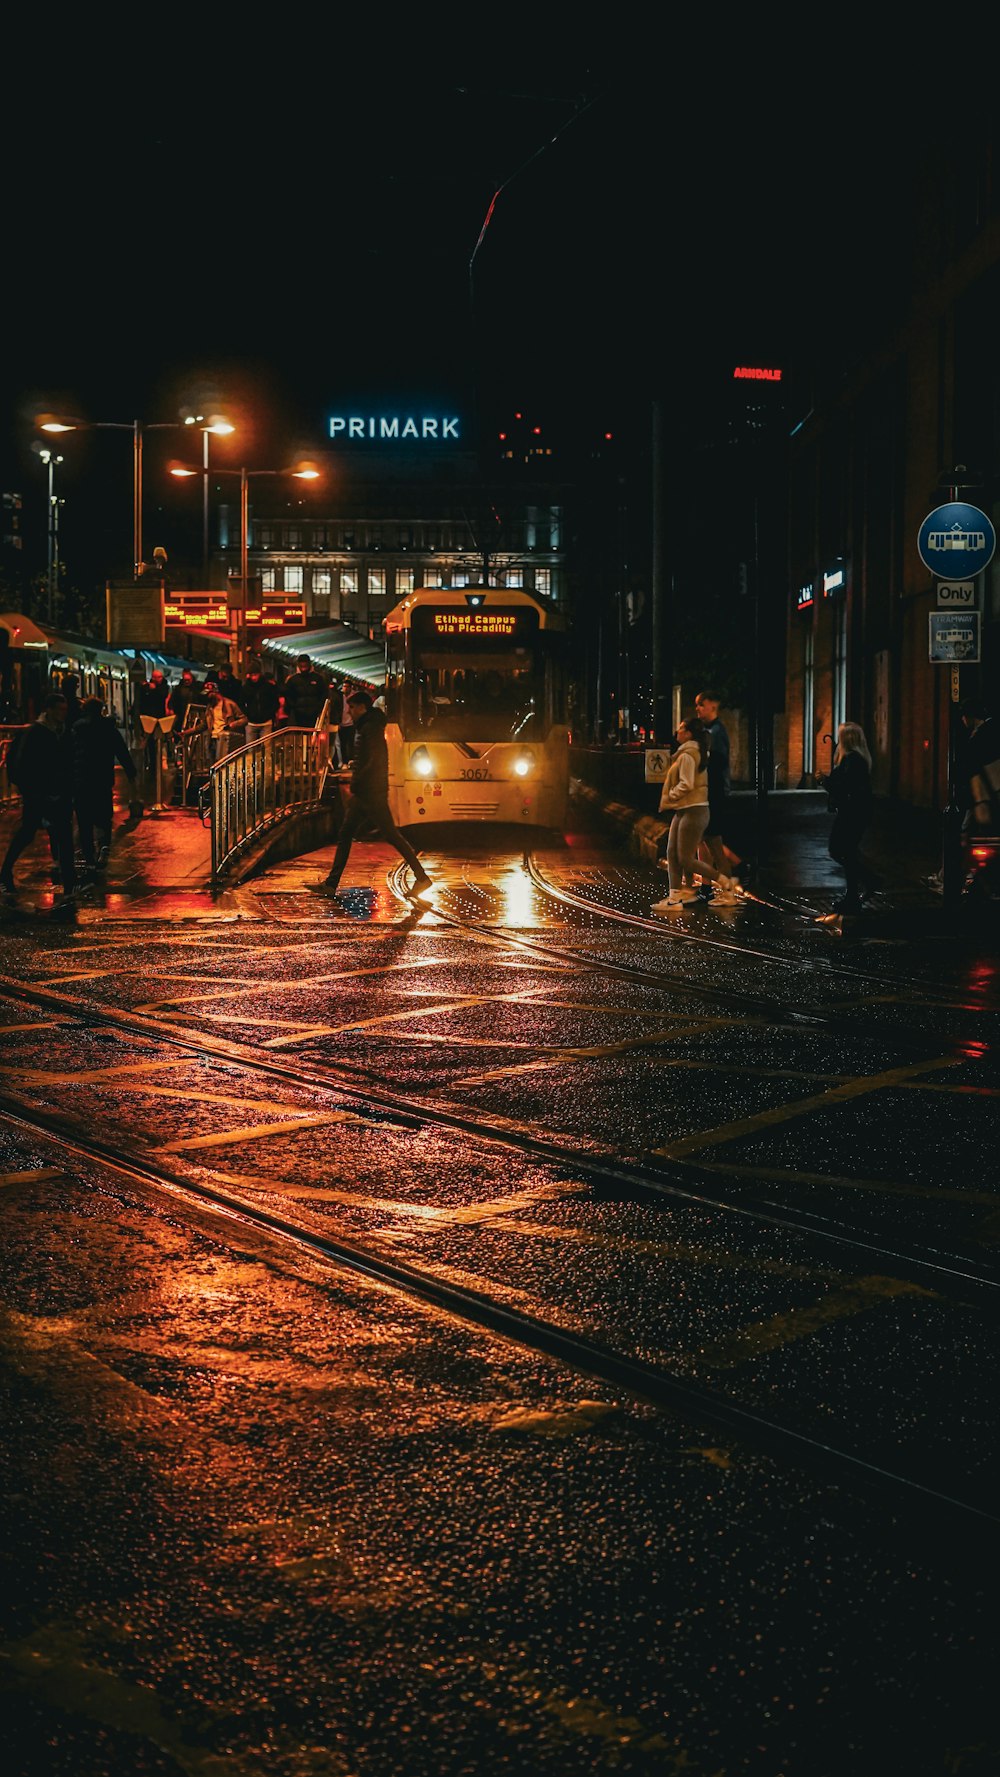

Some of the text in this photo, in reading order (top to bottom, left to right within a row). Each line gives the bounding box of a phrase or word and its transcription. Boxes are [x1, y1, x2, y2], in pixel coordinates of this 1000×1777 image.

[734, 367, 781, 380] ARNDALE
[329, 416, 459, 439] PRIMARK
[940, 587, 972, 602] Only
[435, 615, 516, 625] Etihad Campus
[936, 615, 973, 623] TRAMWAY
[438, 624, 512, 633] via Piccadilly
